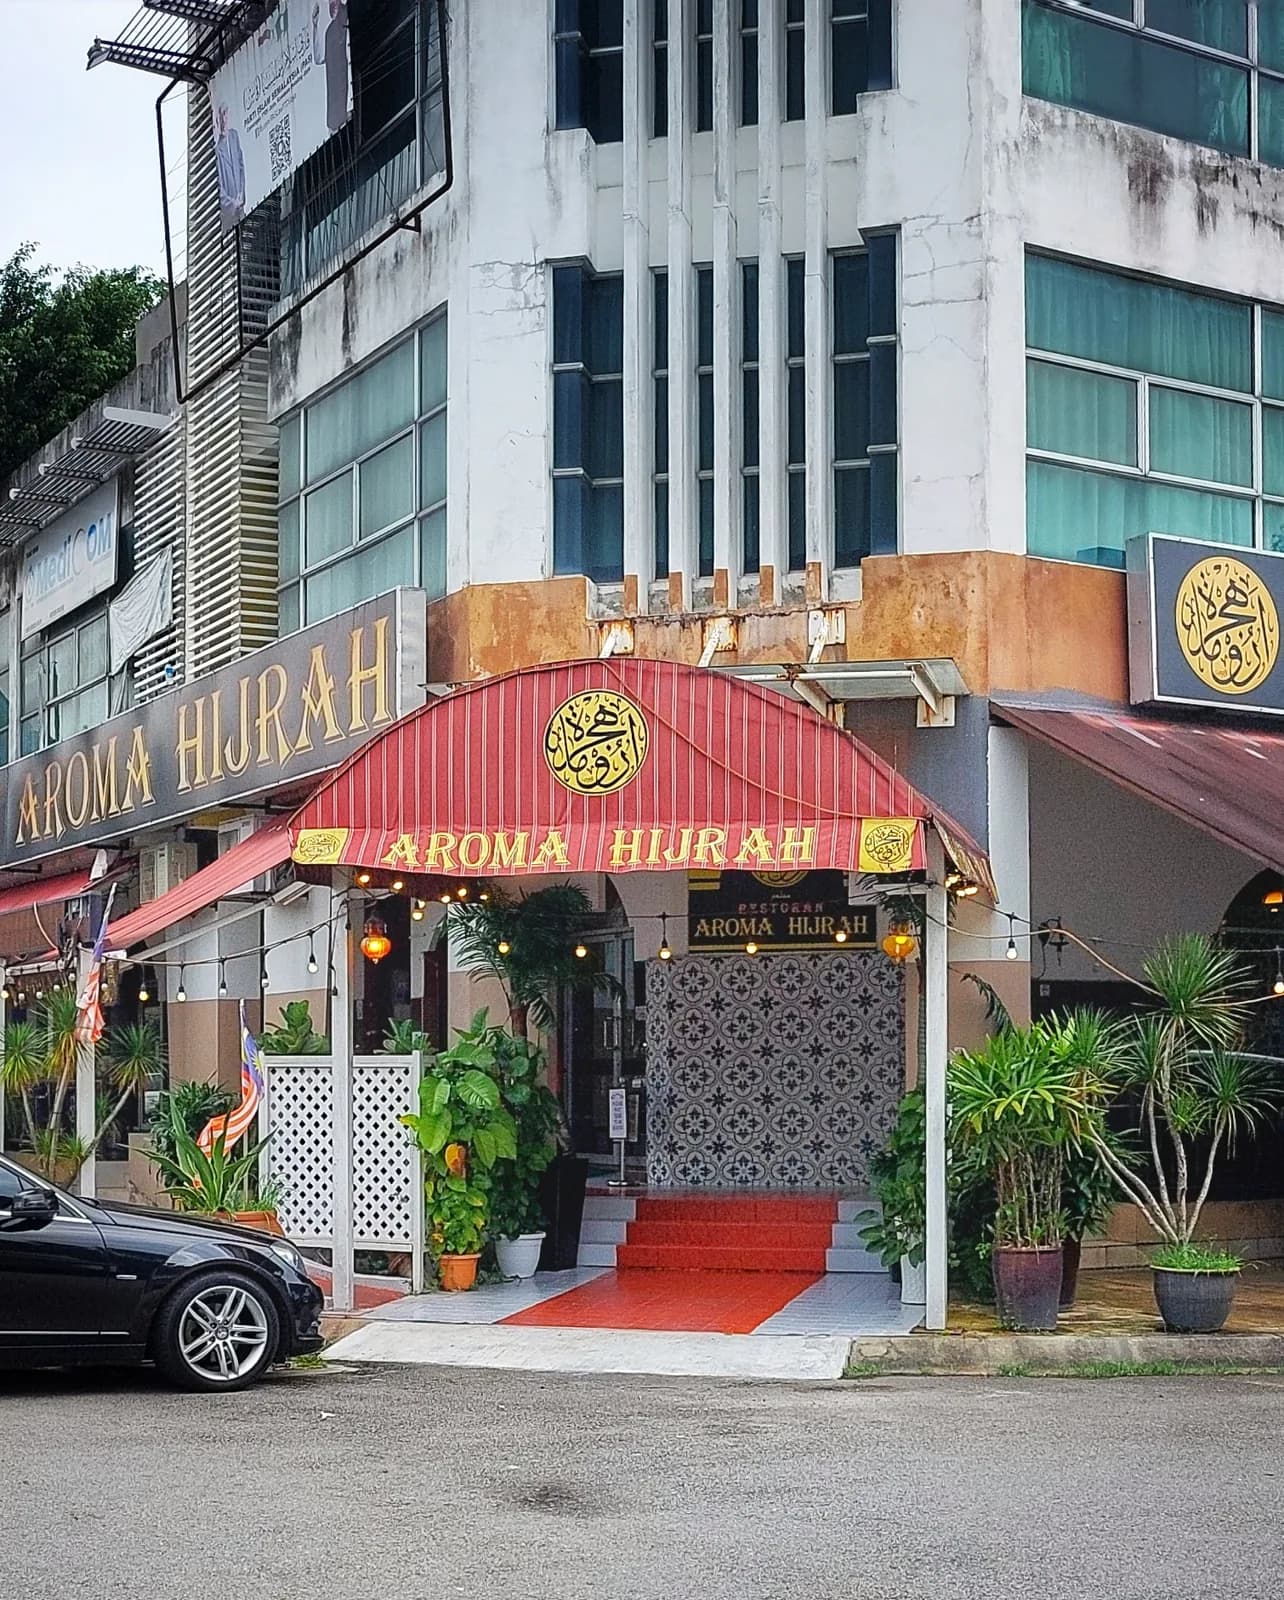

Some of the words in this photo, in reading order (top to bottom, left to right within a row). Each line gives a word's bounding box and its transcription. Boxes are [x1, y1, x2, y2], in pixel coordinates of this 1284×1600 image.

[16, 724, 156, 847] AROMA
[176, 615, 396, 795] HIJRAH
[381, 830, 571, 871] AROMA
[608, 826, 816, 867] HIJRAH
[694, 917, 774, 936] AROMA
[788, 915, 868, 936] HIJRAH
